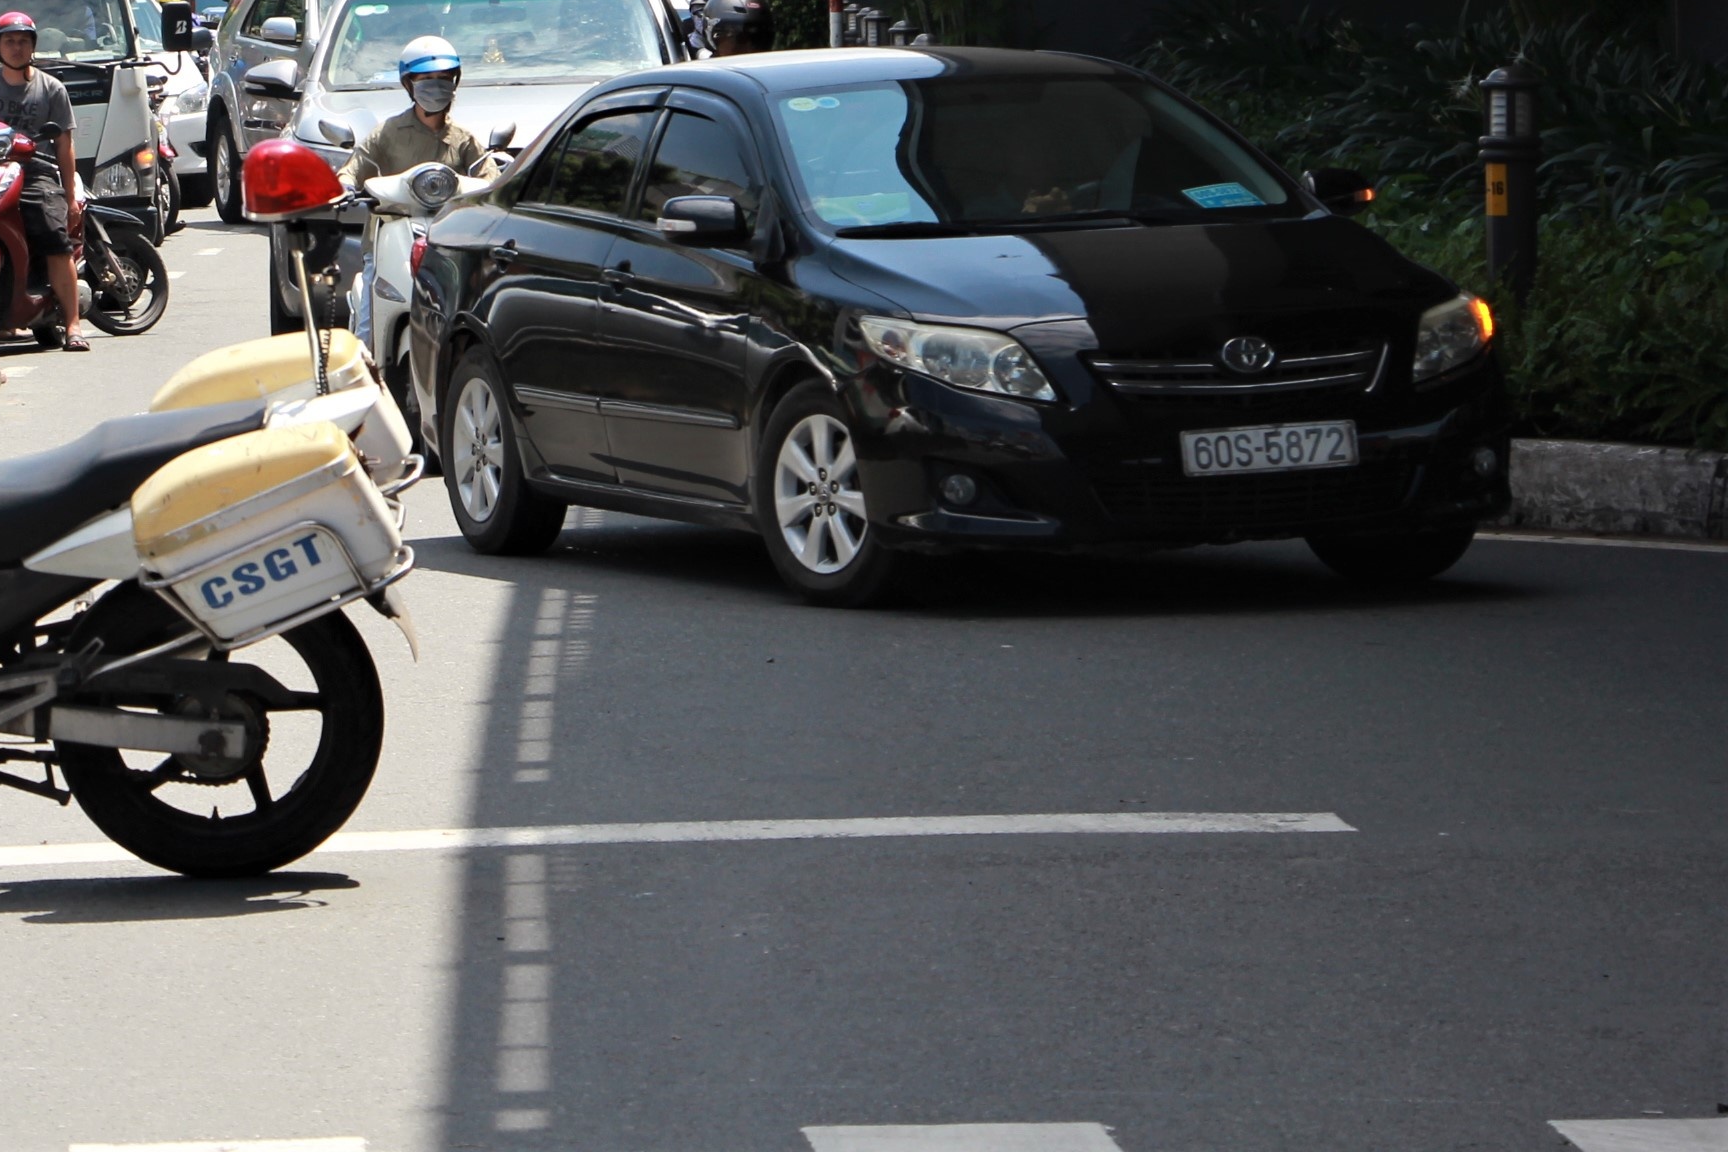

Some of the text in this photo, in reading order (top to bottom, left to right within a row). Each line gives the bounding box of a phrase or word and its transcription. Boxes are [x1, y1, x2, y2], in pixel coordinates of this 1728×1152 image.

[8, 100, 38, 117] BIKE
[1193, 426, 1347, 470] 60S-5872
[200, 533, 324, 610] CSGT
